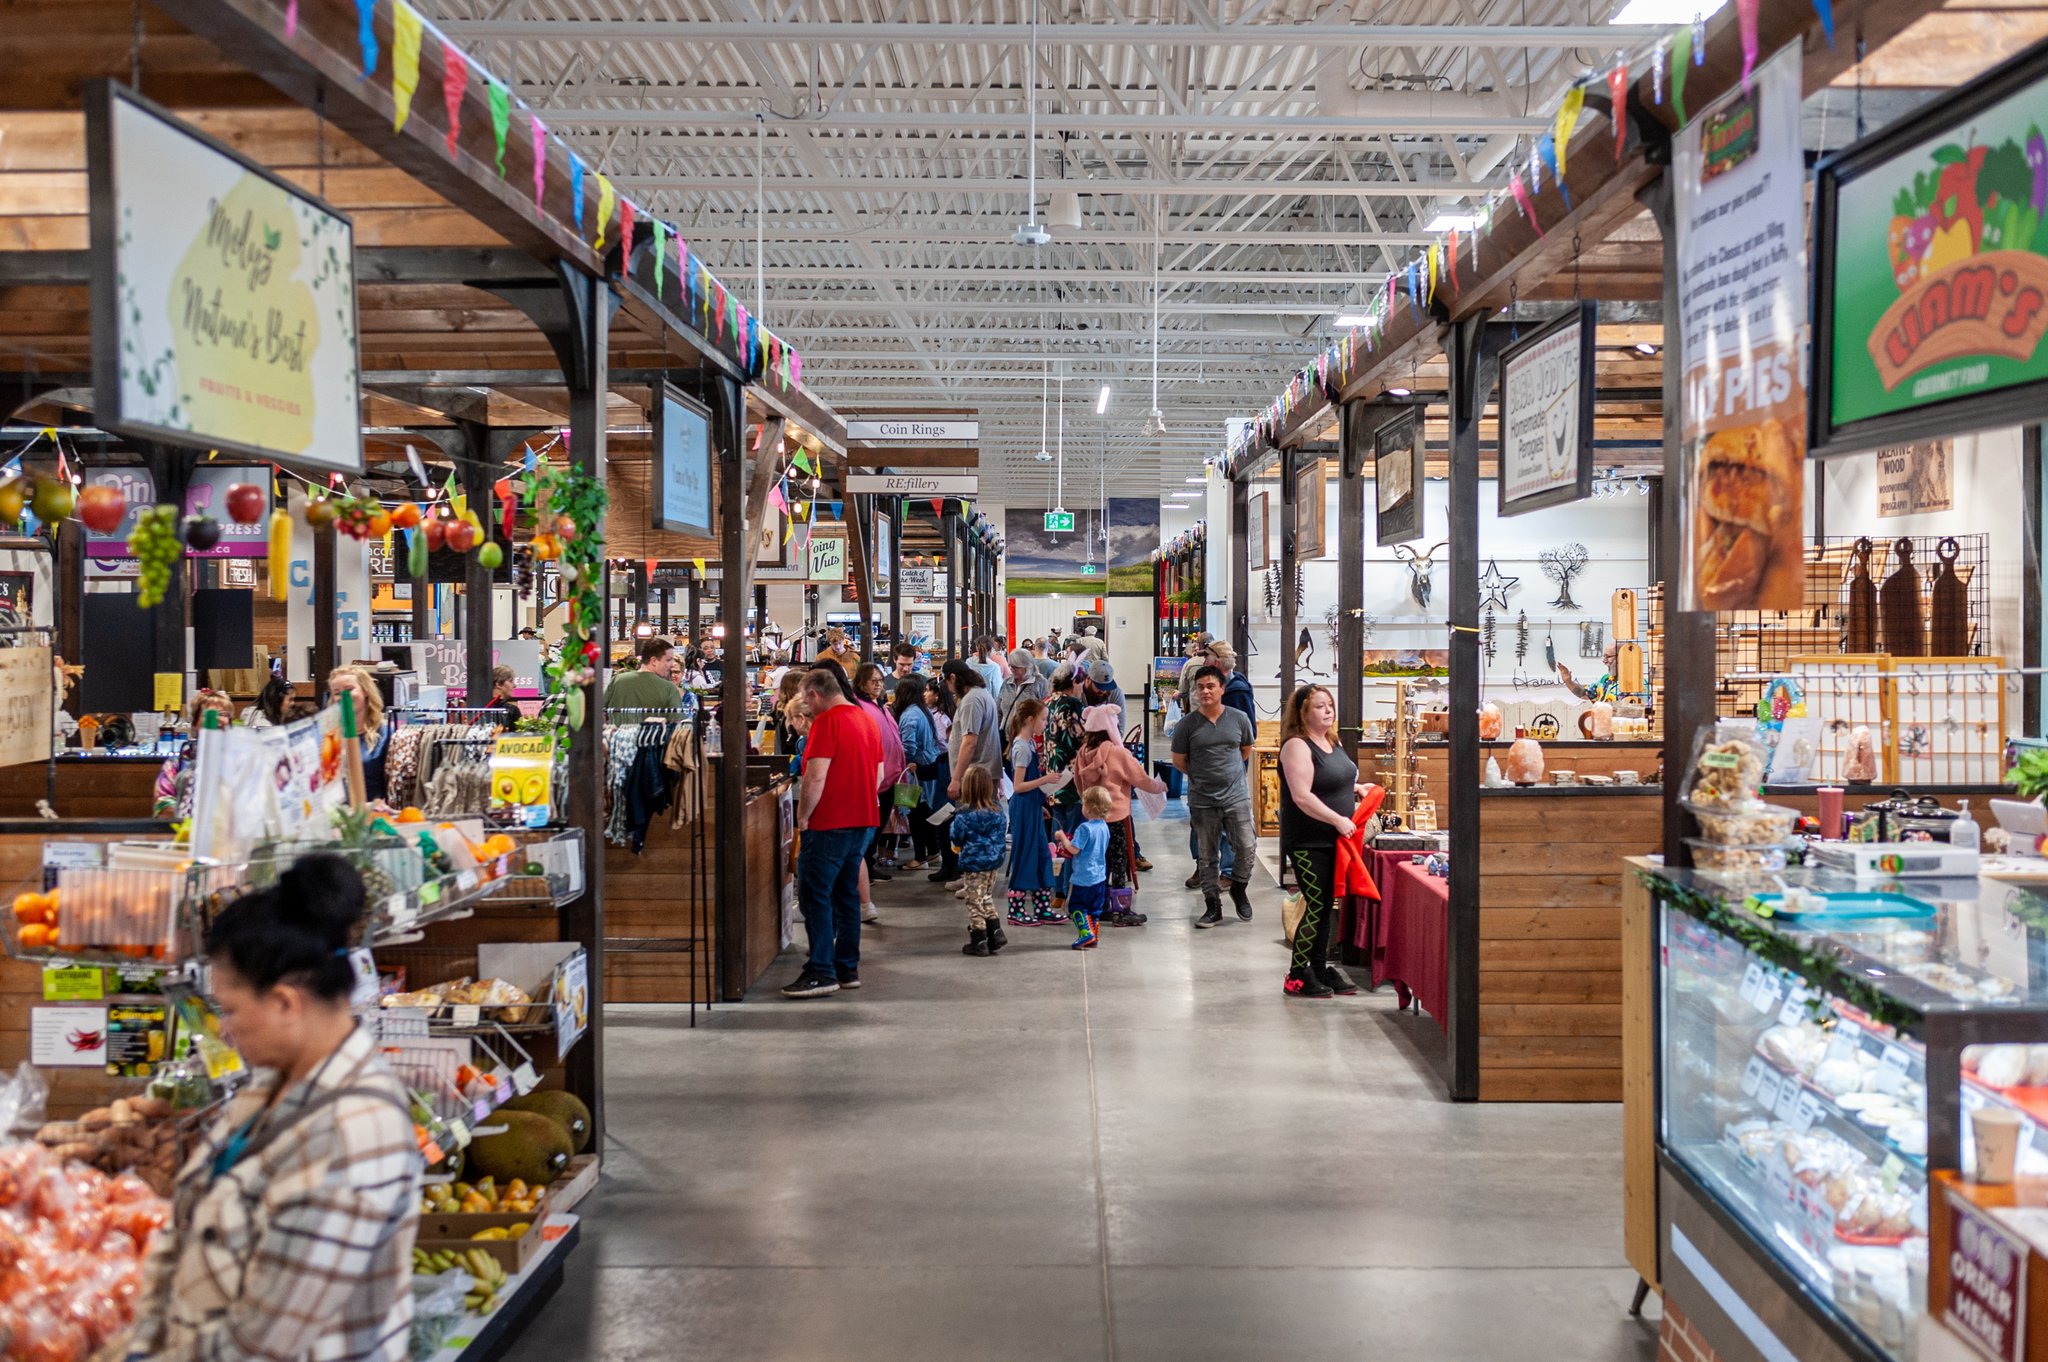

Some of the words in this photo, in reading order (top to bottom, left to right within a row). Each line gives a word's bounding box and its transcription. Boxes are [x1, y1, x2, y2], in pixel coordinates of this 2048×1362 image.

[182, 276, 262, 360] Nature's
[266, 307, 306, 374] Best
[1886, 264, 2044, 368] LIAM'S
[1510, 369, 1535, 416] BABA
[1536, 347, 1580, 401] JODY'S
[1723, 351, 1794, 417] PIES
[880, 423, 907, 435] Coin
[912, 423, 945, 436] Rings
[1510, 408, 1545, 440] Homemade
[1518, 434, 1545, 462] Perogies
[1883, 458, 1905, 475] WOOD
[886, 478, 939, 492] RE:fillery
[1880, 501, 1908, 512] PYROGRAPHY
[810, 552, 840, 575] Nuts
[919, 570, 926, 578] of
[499, 742, 551, 755] AVOCADO
[1951, 1251, 2012, 1324] ORDER
[1955, 1291, 2005, 1354] HERE
